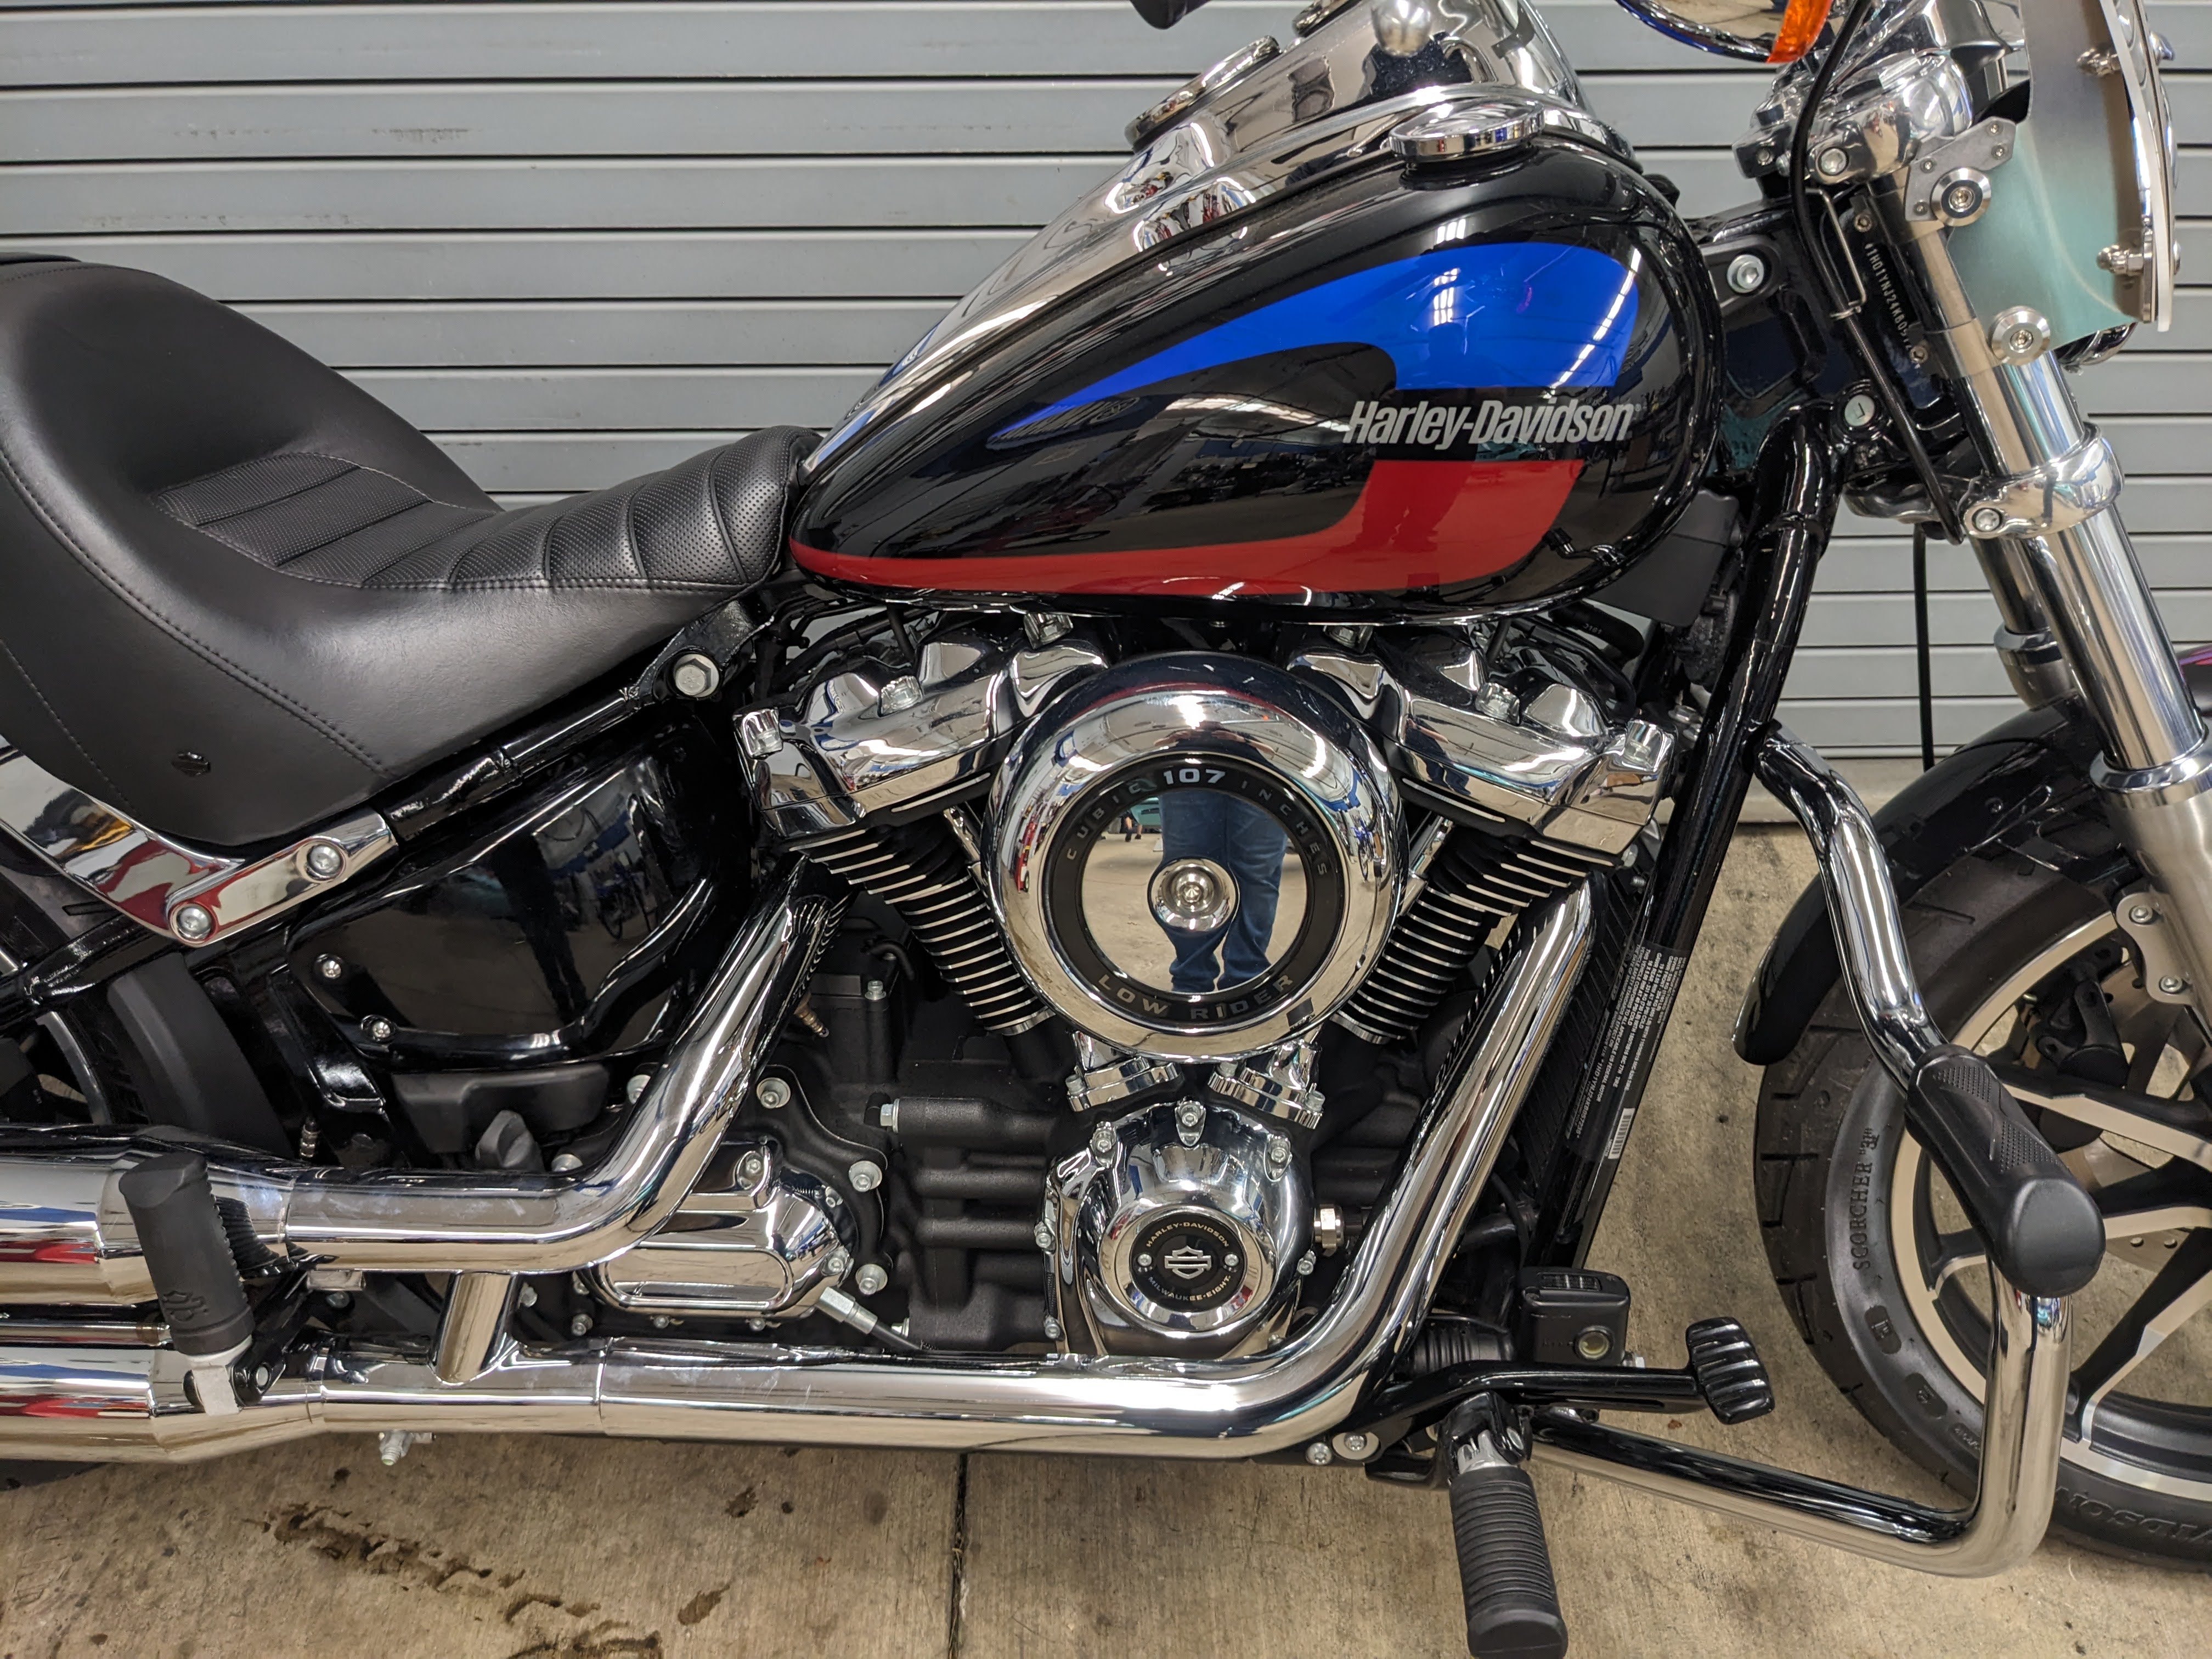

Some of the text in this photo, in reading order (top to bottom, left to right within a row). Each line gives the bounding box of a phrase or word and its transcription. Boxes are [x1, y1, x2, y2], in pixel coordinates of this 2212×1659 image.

[1066, 768, 1327, 876] CUBIC 107 INCHES
[1629, 953, 1638, 967] DATE
[1634, 946, 1646, 967] VEHICLE
[1643, 948, 1651, 961] THIS
[1652, 951, 1662, 968] GAWR
[1628, 966, 1639, 986] SAFETY
[1635, 960, 1647, 981] VEHICLE
[1647, 967, 1657, 982] REAR
[1658, 970, 1668, 988] FRONT
[1098, 974, 1294, 1019] LOW RIDER
[1618, 985, 1632, 1015] STANDARDS
[1626, 980, 1640, 1009] CONFORMS
[1609, 1010, 1619, 1029] SHOWN
[1627, 1011, 1636, 1026] COLD
[1630, 1019, 1640, 1032] WITH
[1638, 1014, 1647, 1029] COLD
[1610, 1020, 1621, 1040] EFFECT
[1611, 1025, 1626, 1055] APPLICABLE
[1601, 1061, 1613, 1084] FEDERAL
[1612, 1075, 1621, 1088] TIRE
[1595, 1084, 1606, 1102] MOTOR
[1849, 1161, 1873, 1271] SCORCHER
[1146, 1221, 1229, 1248] HARLEY-DAVIDSON
